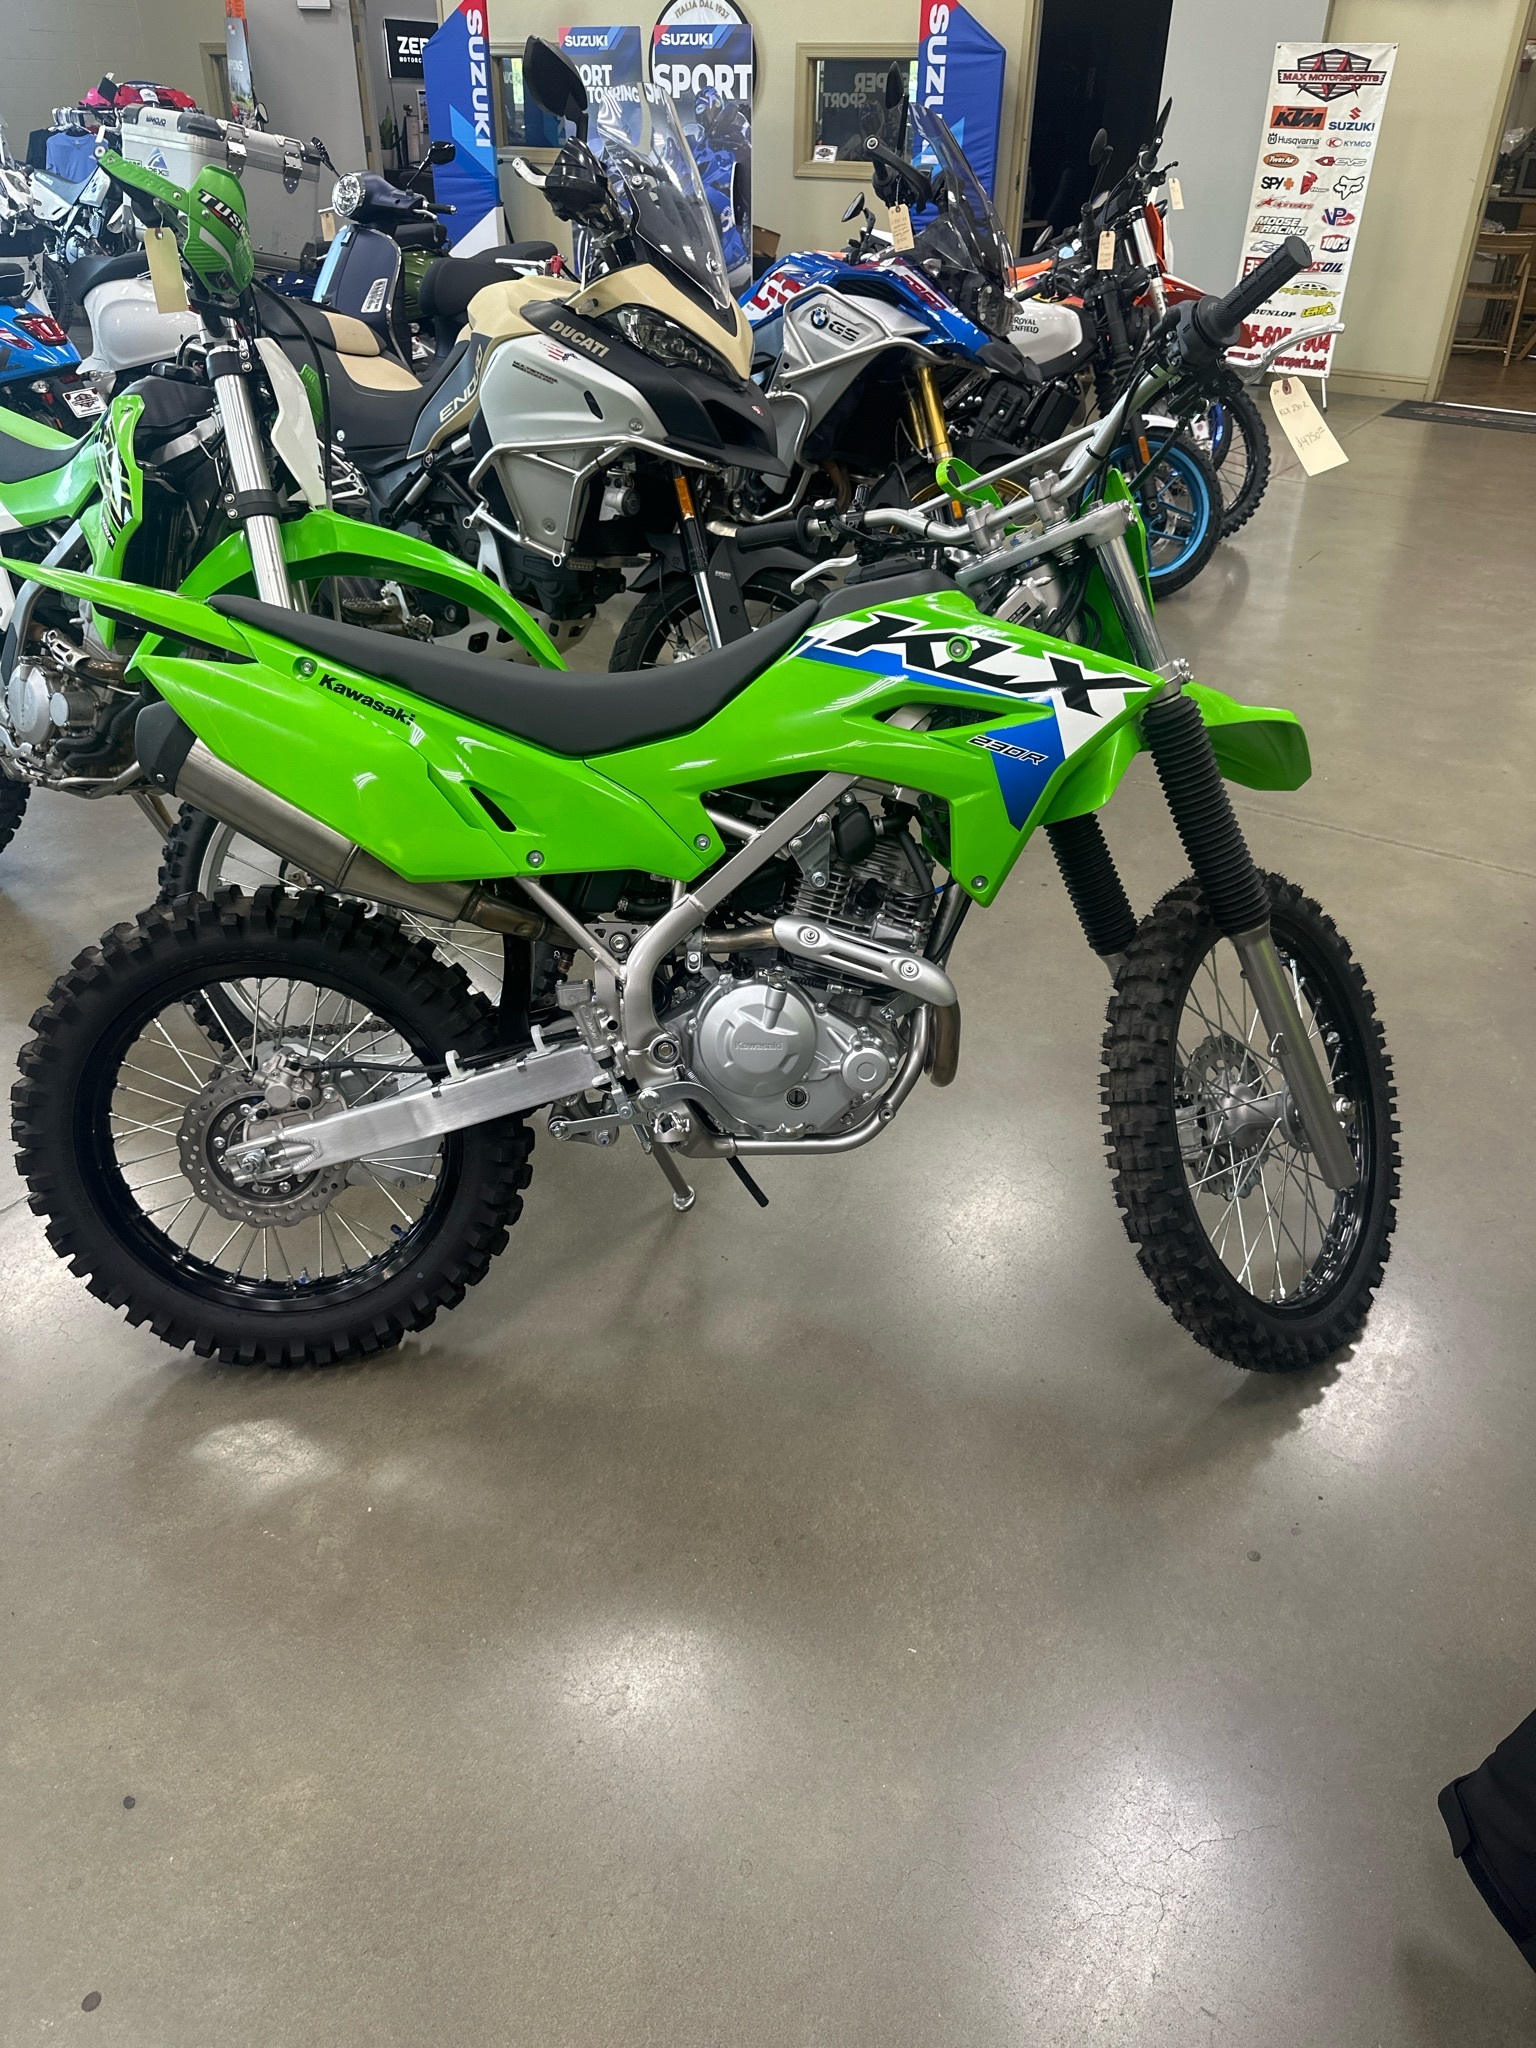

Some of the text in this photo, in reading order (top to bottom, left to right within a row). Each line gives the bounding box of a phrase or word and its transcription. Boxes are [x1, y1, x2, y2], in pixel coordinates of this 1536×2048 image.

[674, 0, 731, 20] ITALIA DAL 1937
[564, 34, 609, 47] SUZUKI
[660, 32, 713, 46] SUZUKI
[399, 56, 423, 64] MOTORC
[466, 8, 492, 148] SUZUKI
[653, 63, 753, 100] SPORT
[1282, 73, 1380, 83] MAX MOTORSPORTS
[1272, 107, 1324, 127] KTM
[1328, 121, 1376, 132] SUZUKI
[1277, 135, 1320, 148] Husqvarna
[1343, 140, 1372, 148] KYMCO
[1255, 215, 1302, 226] MOOSE
[1324, 207, 1348, 226] VP
[1259, 225, 1309, 236] RACING
[1322, 237, 1349, 251] 100%
[1013, 316, 1037, 326] ROYAL
[828, 320, 860, 342] GS
[1011, 324, 1040, 334] ENFIELD
[548, 319, 610, 359] DUCATI
[820, 610, 1154, 719] KLX
[318, 673, 417, 727] Kawasaki
[967, 735, 1049, 766] 230R
[734, 1040, 784, 1051] Kawasaki
